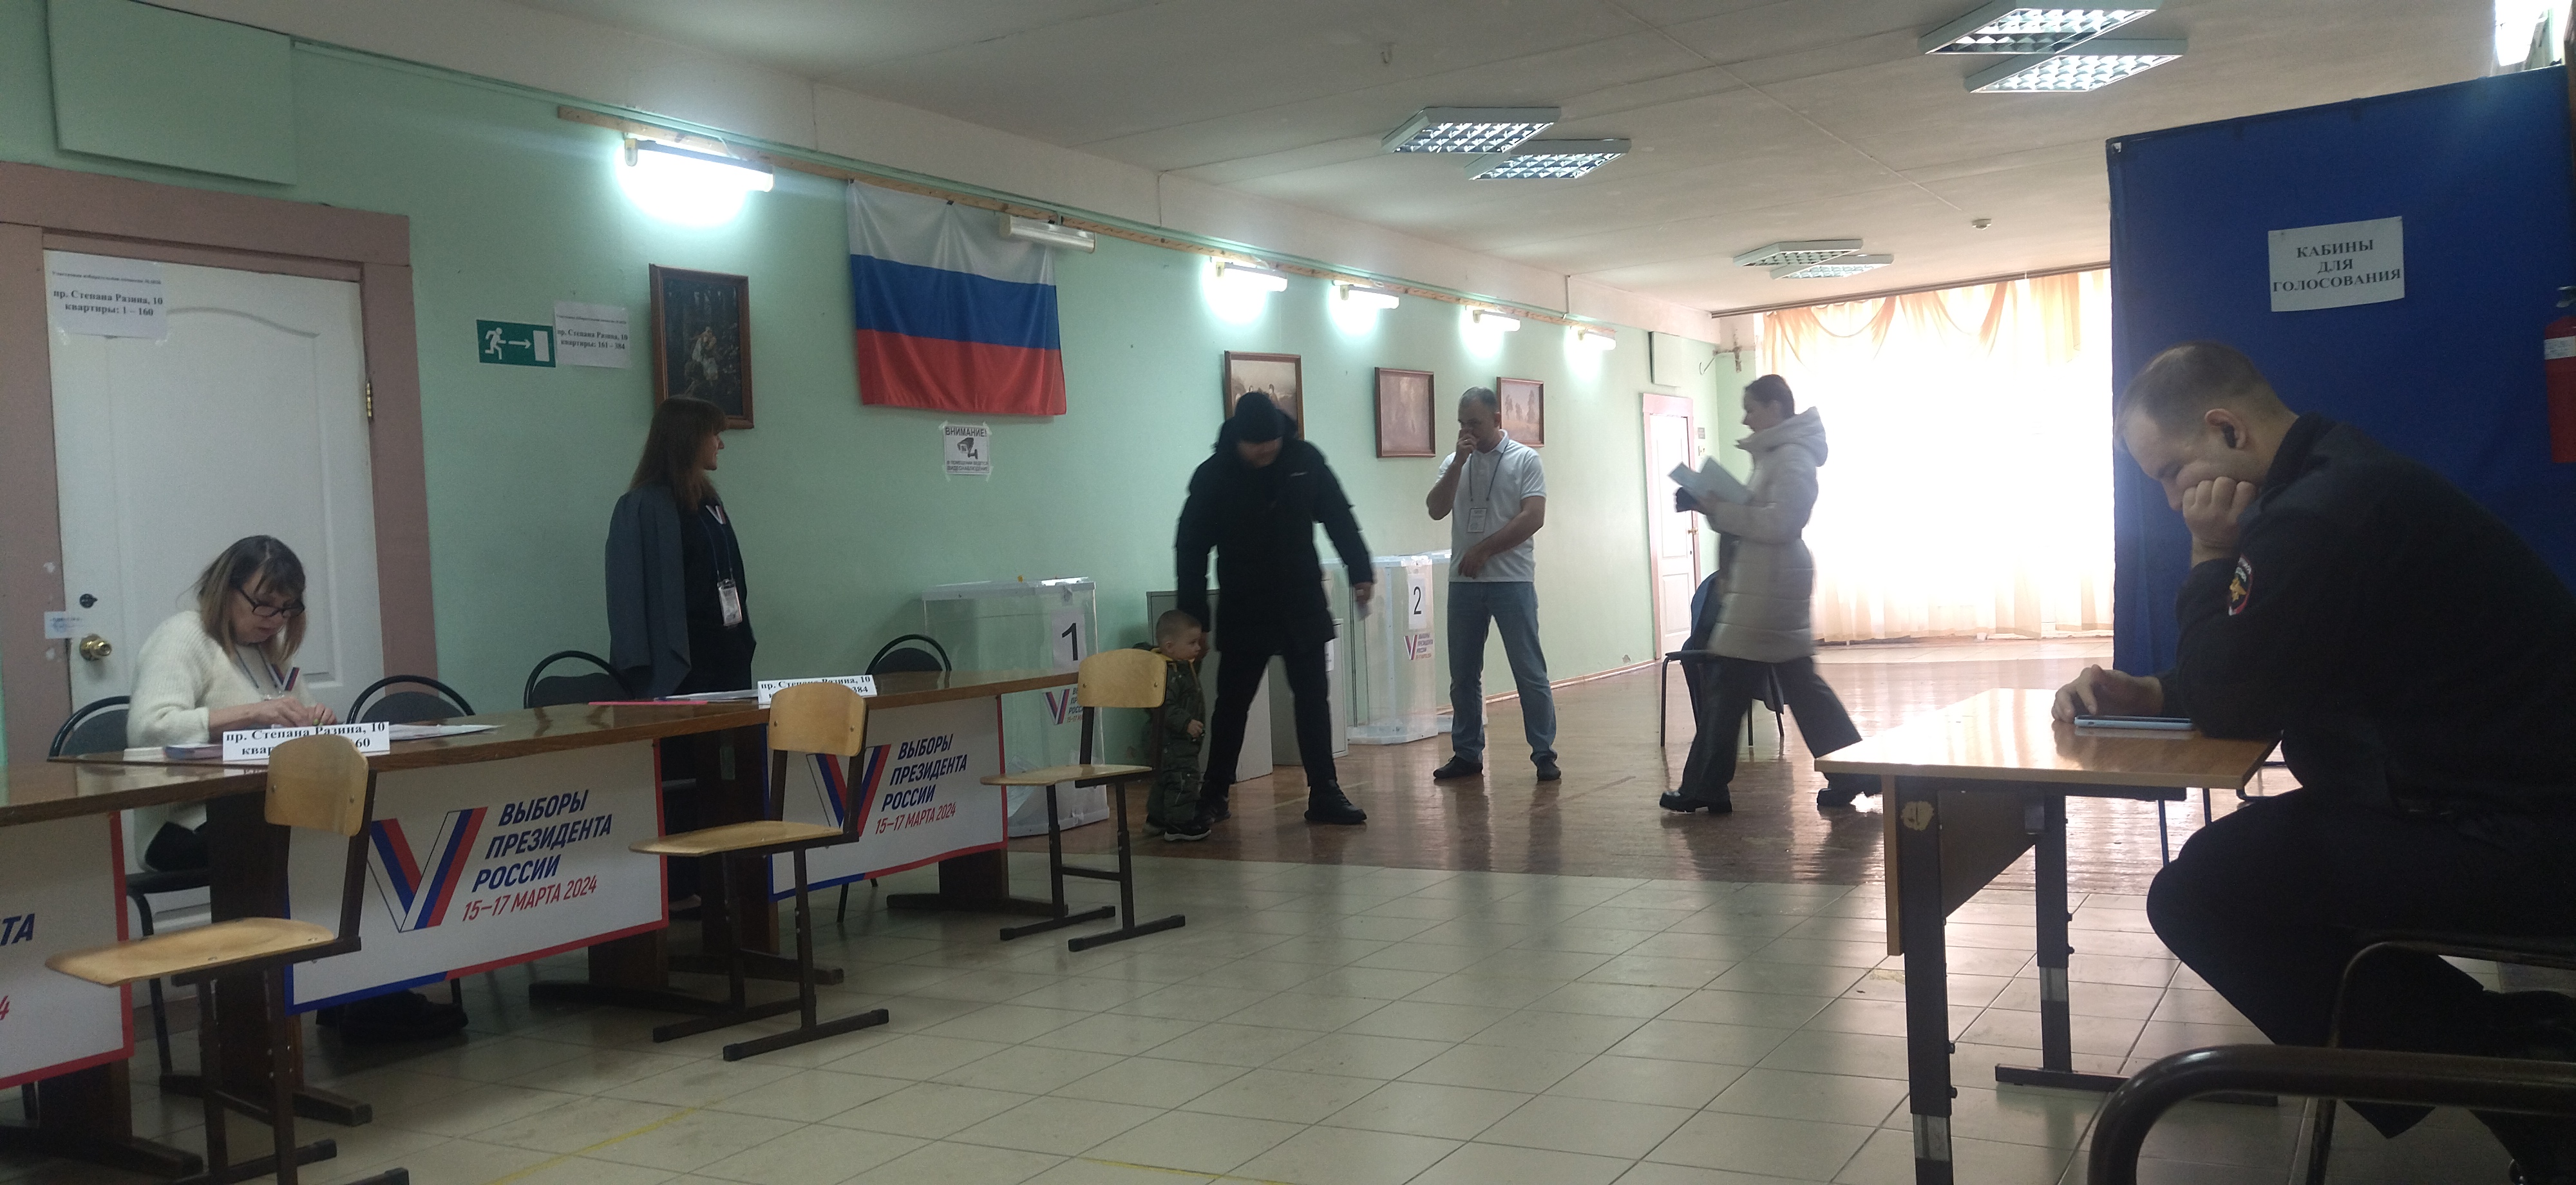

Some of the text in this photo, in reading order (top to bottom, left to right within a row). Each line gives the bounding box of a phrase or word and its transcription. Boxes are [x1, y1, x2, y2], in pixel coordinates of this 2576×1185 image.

[2297, 240, 2374, 258] КАБИНЫ
[2317, 259, 2353, 274] ДЛЯ
[2273, 269, 2401, 292] ГОЛОСОВАНИЯ
[54, 290, 163, 305] пр. Степана Разина, 10
[65, 303, 119, 314] квартиры:
[138, 308, 153, 316] 160
[568, 328, 594, 337] Степана
[945, 427, 987, 437] ВНИМАНИЕ!
[1413, 586, 1422, 615] 2
[1061, 622, 1078, 661] 1
[227, 734, 247, 743] пр.
[252, 728, 309, 740] Степана
[372, 722, 385, 732] 10
[898, 734, 953, 760] ВЫБОРЫ
[889, 754, 967, 786] ПРЕЗИДЕНТА
[498, 790, 589, 827] ВЫБОРЫ
[881, 784, 936, 812] РОССИИ
[905, 808, 935, 829] МАРТА
[936, 802, 956, 821] 2024
[485, 814, 613, 860] ПРЕЗИДЕНТА
[472, 854, 562, 893] РОССИИ
[511, 883, 560, 913] МАРТА
[564, 875, 597, 900] 2024
